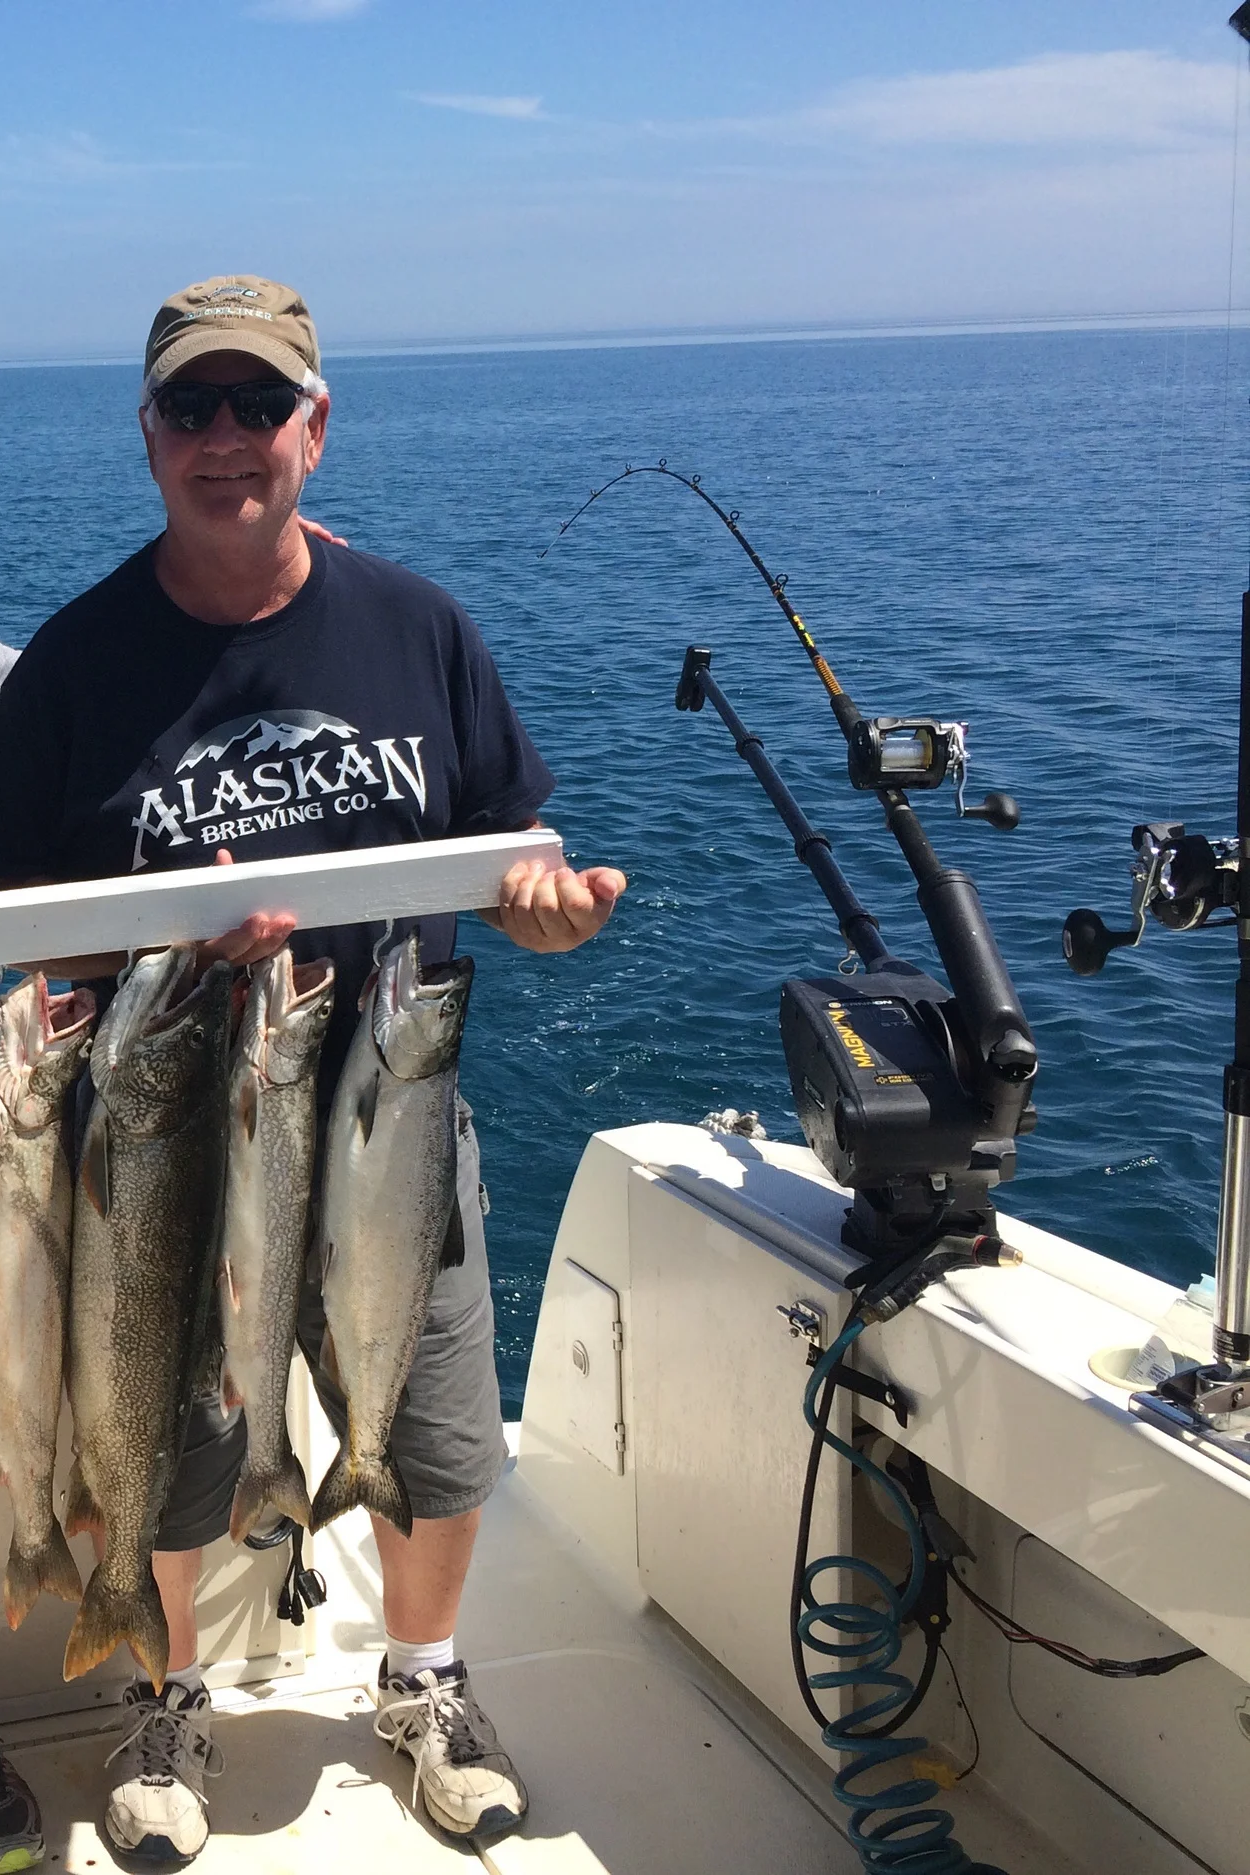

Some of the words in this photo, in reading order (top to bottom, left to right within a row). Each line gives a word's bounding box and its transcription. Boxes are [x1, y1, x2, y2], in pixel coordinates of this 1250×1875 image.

[131, 736, 426, 872] ALASKAN
[200, 801, 325, 846] BREWING
[333, 793, 377, 816] CO.
